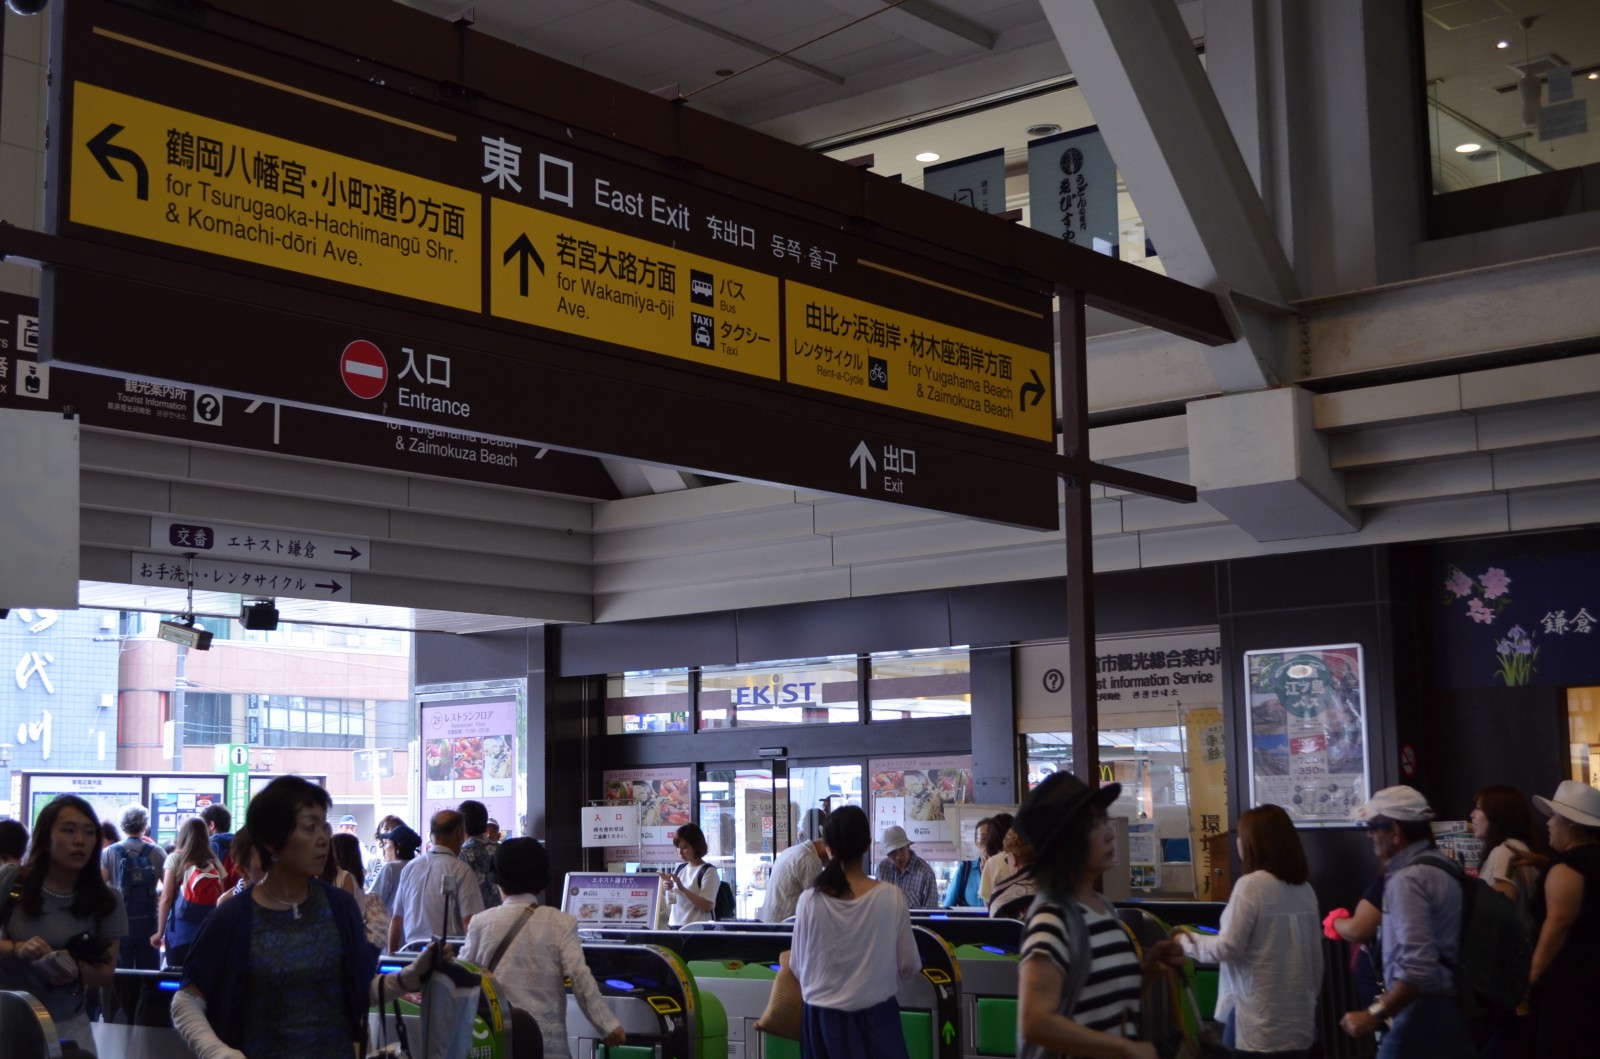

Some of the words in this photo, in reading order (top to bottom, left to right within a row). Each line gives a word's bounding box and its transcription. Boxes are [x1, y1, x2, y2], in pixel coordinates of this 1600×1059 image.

[165, 128, 466, 240] 鶴岡八幡宮・小町通り方面
[480, 135, 574, 208] 東口
[166, 173, 193, 198] for
[198, 180, 421, 256] Tsurugaoka-Hachimangū
[426, 239, 459, 264] Shr.
[595, 178, 644, 218] East
[651, 195, 690, 232] Exit
[165, 202, 180, 223] &
[188, 207, 317, 256] Komachi-dōri
[323, 240, 363, 266] Ave.
[706, 214, 756, 250] 东出口
[556, 233, 676, 295] 若宮大路方面
[770, 234, 802, 264] 동쪽
[808, 246, 839, 273] 출구
[557, 272, 576, 293] for
[580, 276, 675, 320] Wakamiya-ōji
[720, 278, 746, 302] バス
[557, 298, 589, 320] Ave.
[692, 314, 713, 328] TAXI
[720, 299, 736, 315] Bus
[720, 321, 771, 346] タクシー
[720, 342, 738, 357] Taxi
[794, 338, 863, 371] レンタサイクル
[397, 346, 451, 389] 入口
[817, 364, 864, 386] Rent-a-Cycle
[908, 360, 922, 378] for
[925, 365, 981, 393] Yuigahama
[983, 380, 1013, 401] Beach
[117, 392, 144, 405] Tourist
[145, 395, 187, 412] Information
[124, 379, 187, 401] 観光案内所
[398, 387, 471, 418] Entrance
[916, 383, 925, 398] &
[927, 385, 981, 412] Zaimokuza
[983, 400, 1014, 420] Beach
[395, 435, 405, 451] &
[409, 437, 477, 462] Zaimokuza
[480, 448, 518, 468] Beach
[883, 445, 916, 476] 出口
[884, 476, 904, 494] Exit
[177, 527, 208, 549] 交番
[228, 535, 317, 559] エキスト鎌倉
[1540, 607, 1598, 635] 鎌倉
[1173, 670, 1213, 685] Service
[444, 711, 494, 722] レストランフロア
[594, 813, 622, 821] 入口
